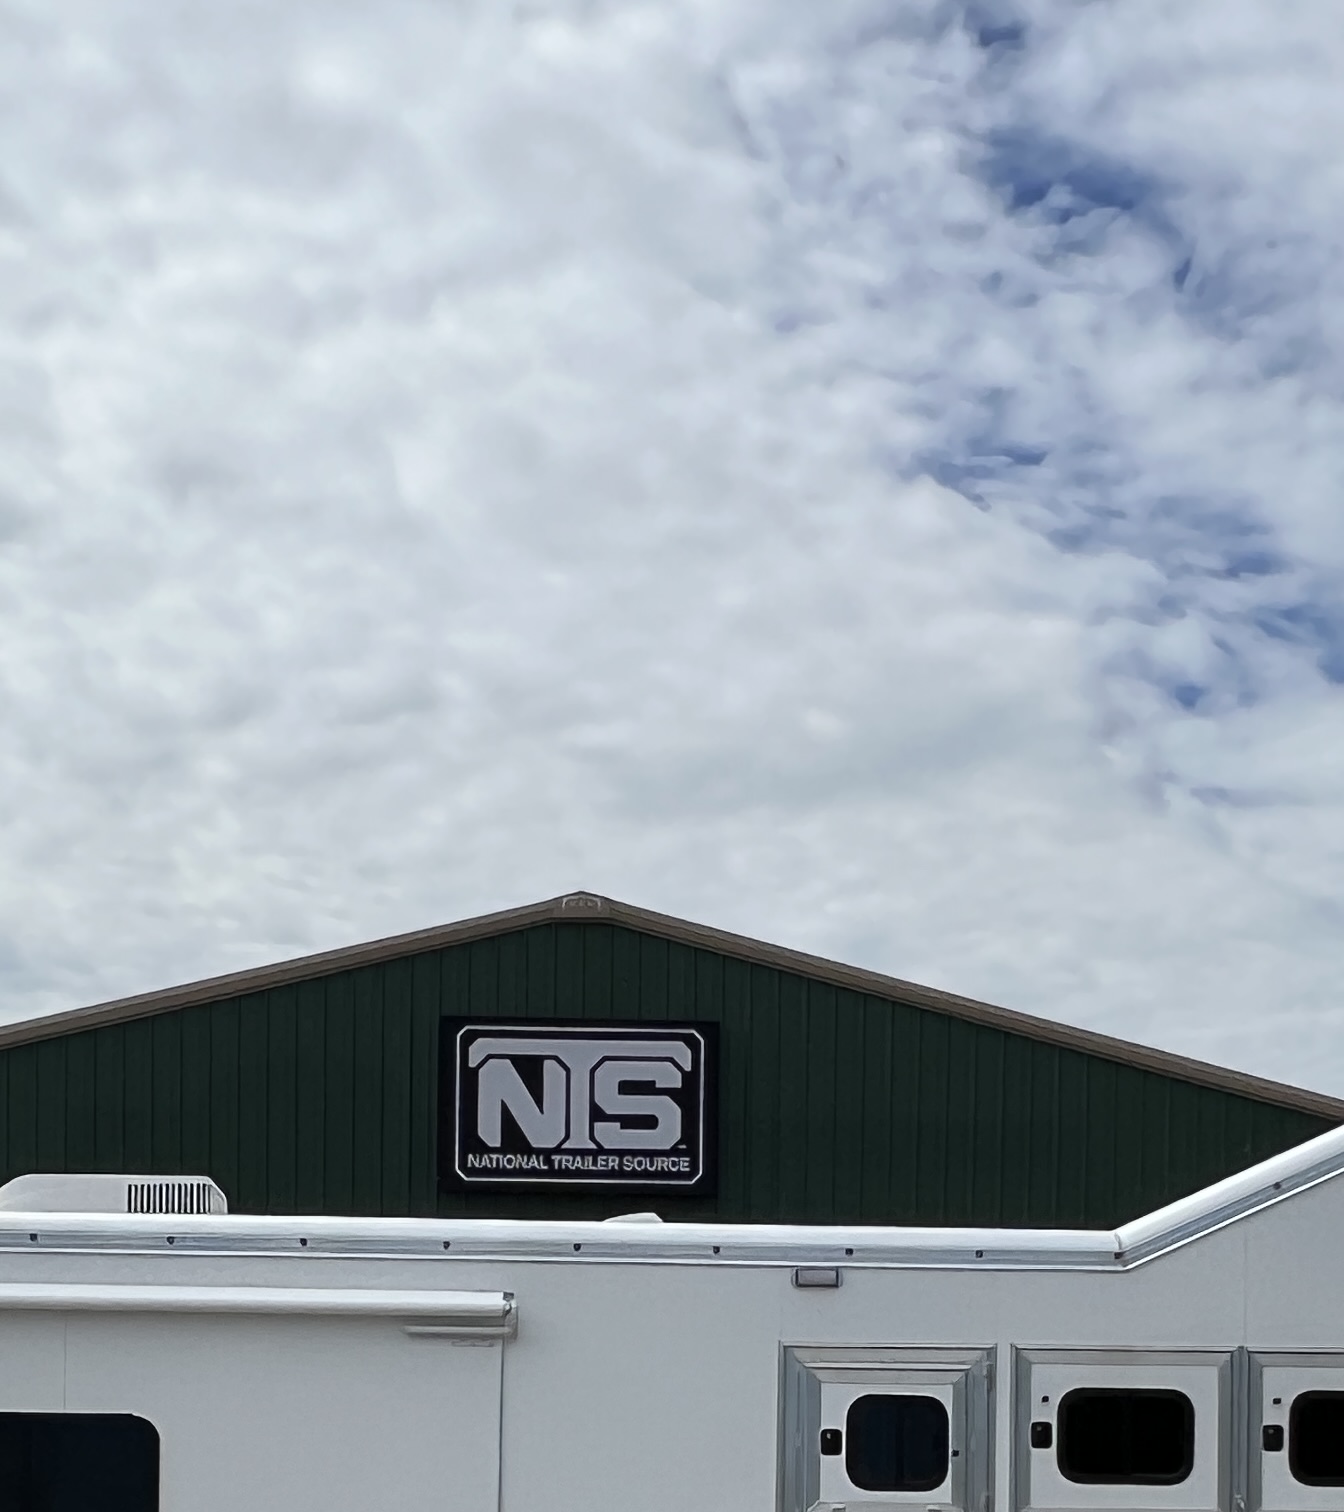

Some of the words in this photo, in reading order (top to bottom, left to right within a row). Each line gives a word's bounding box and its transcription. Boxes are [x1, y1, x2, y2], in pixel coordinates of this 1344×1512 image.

[468, 1038, 692, 1149] NTS
[467, 1153, 548, 1169] NATIONAL
[551, 1155, 619, 1170] TRAILER
[622, 1156, 690, 1171] SOURCE
